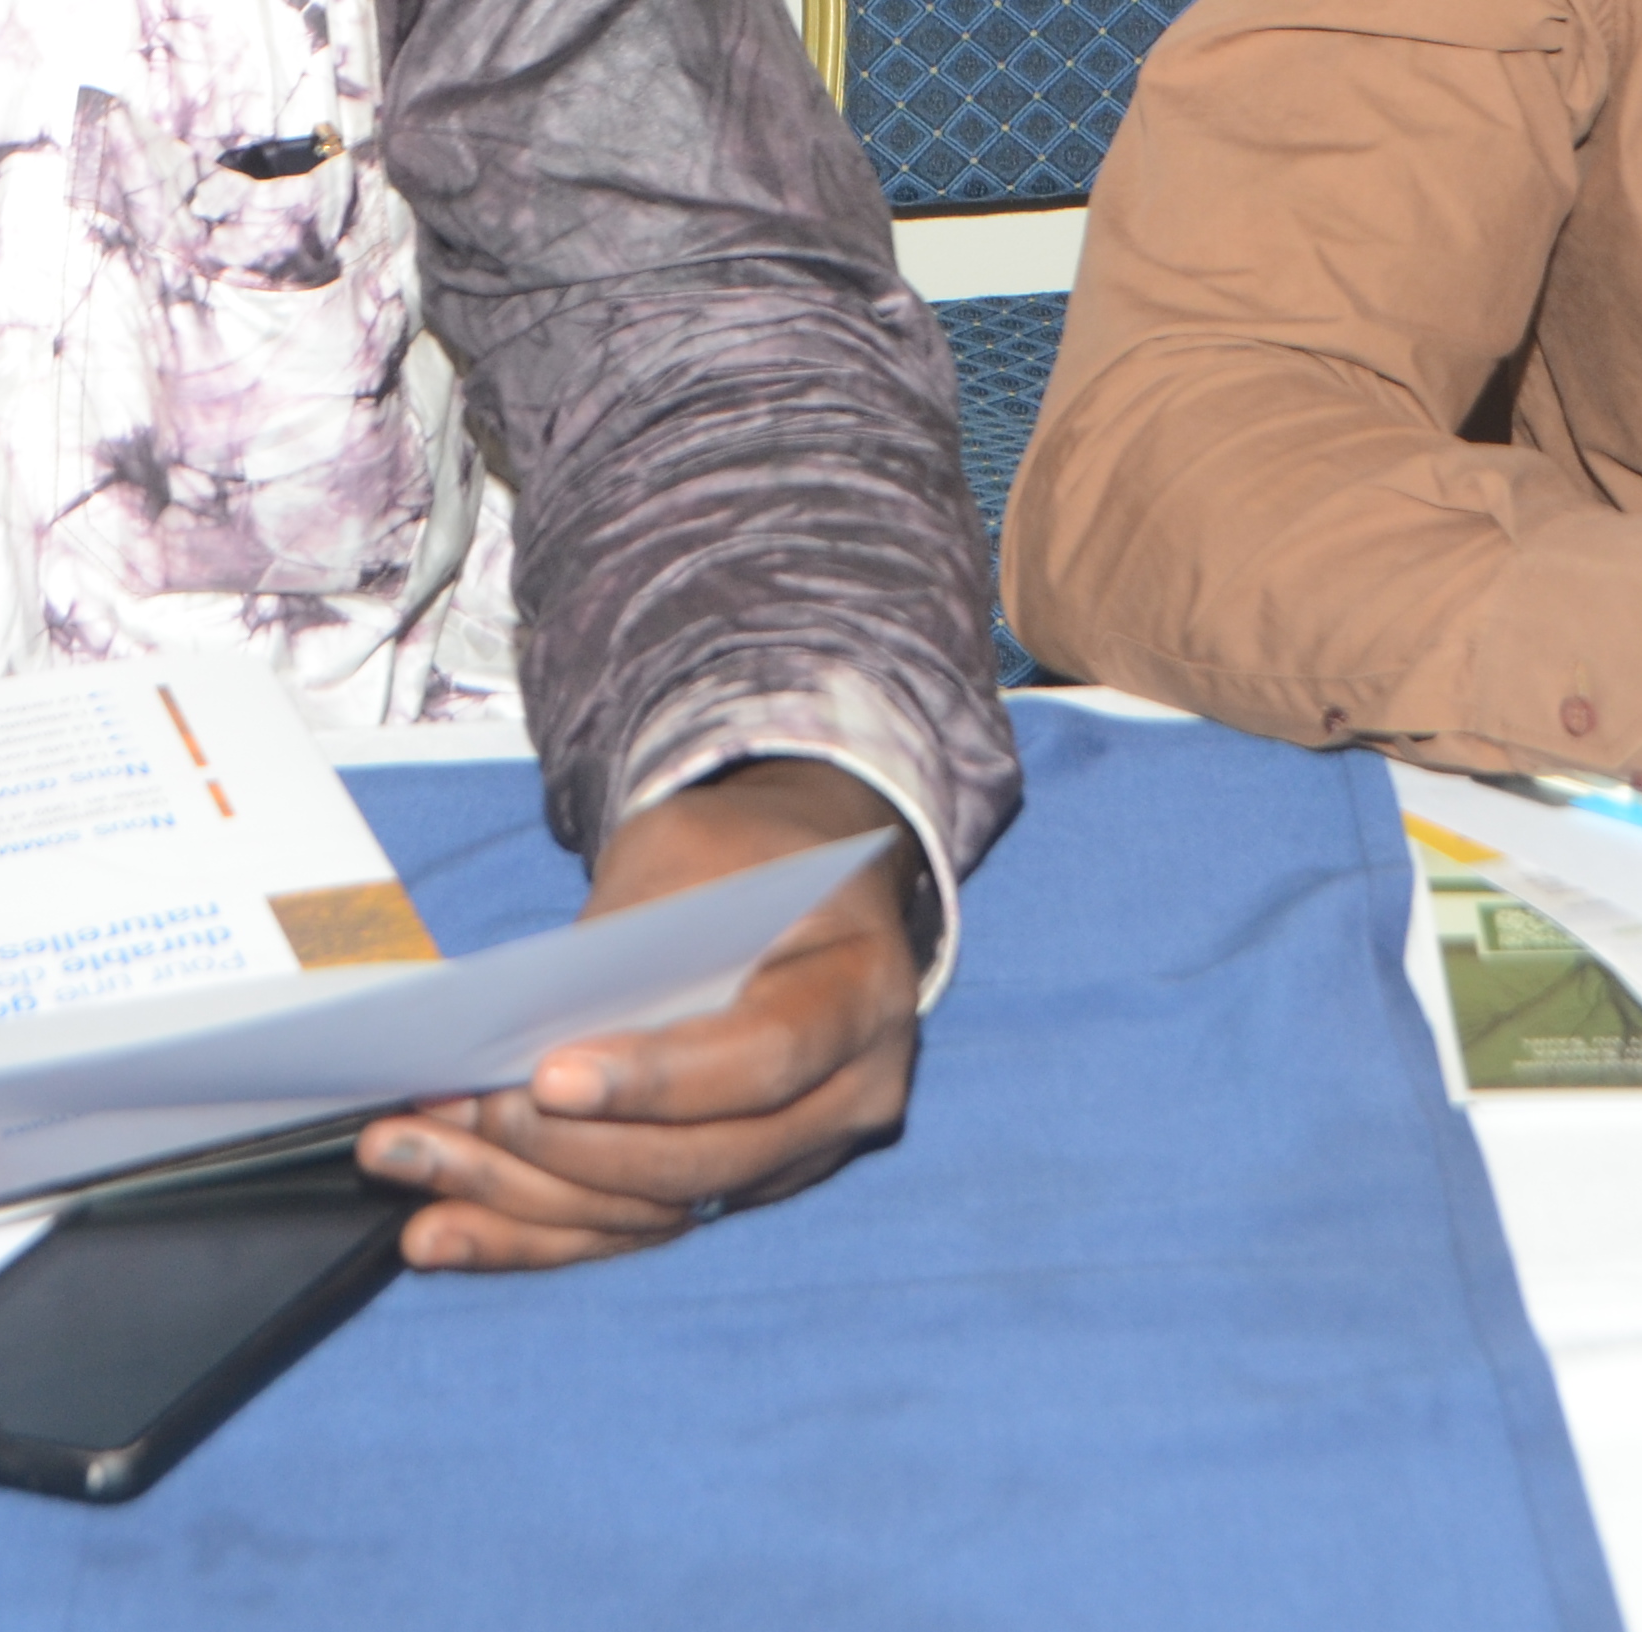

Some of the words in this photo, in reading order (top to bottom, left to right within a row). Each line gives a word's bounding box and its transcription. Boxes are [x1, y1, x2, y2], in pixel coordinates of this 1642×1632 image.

[61, 924, 230, 977] durable
[151, 947, 245, 985] Pour
[53, 971, 132, 1003] une
